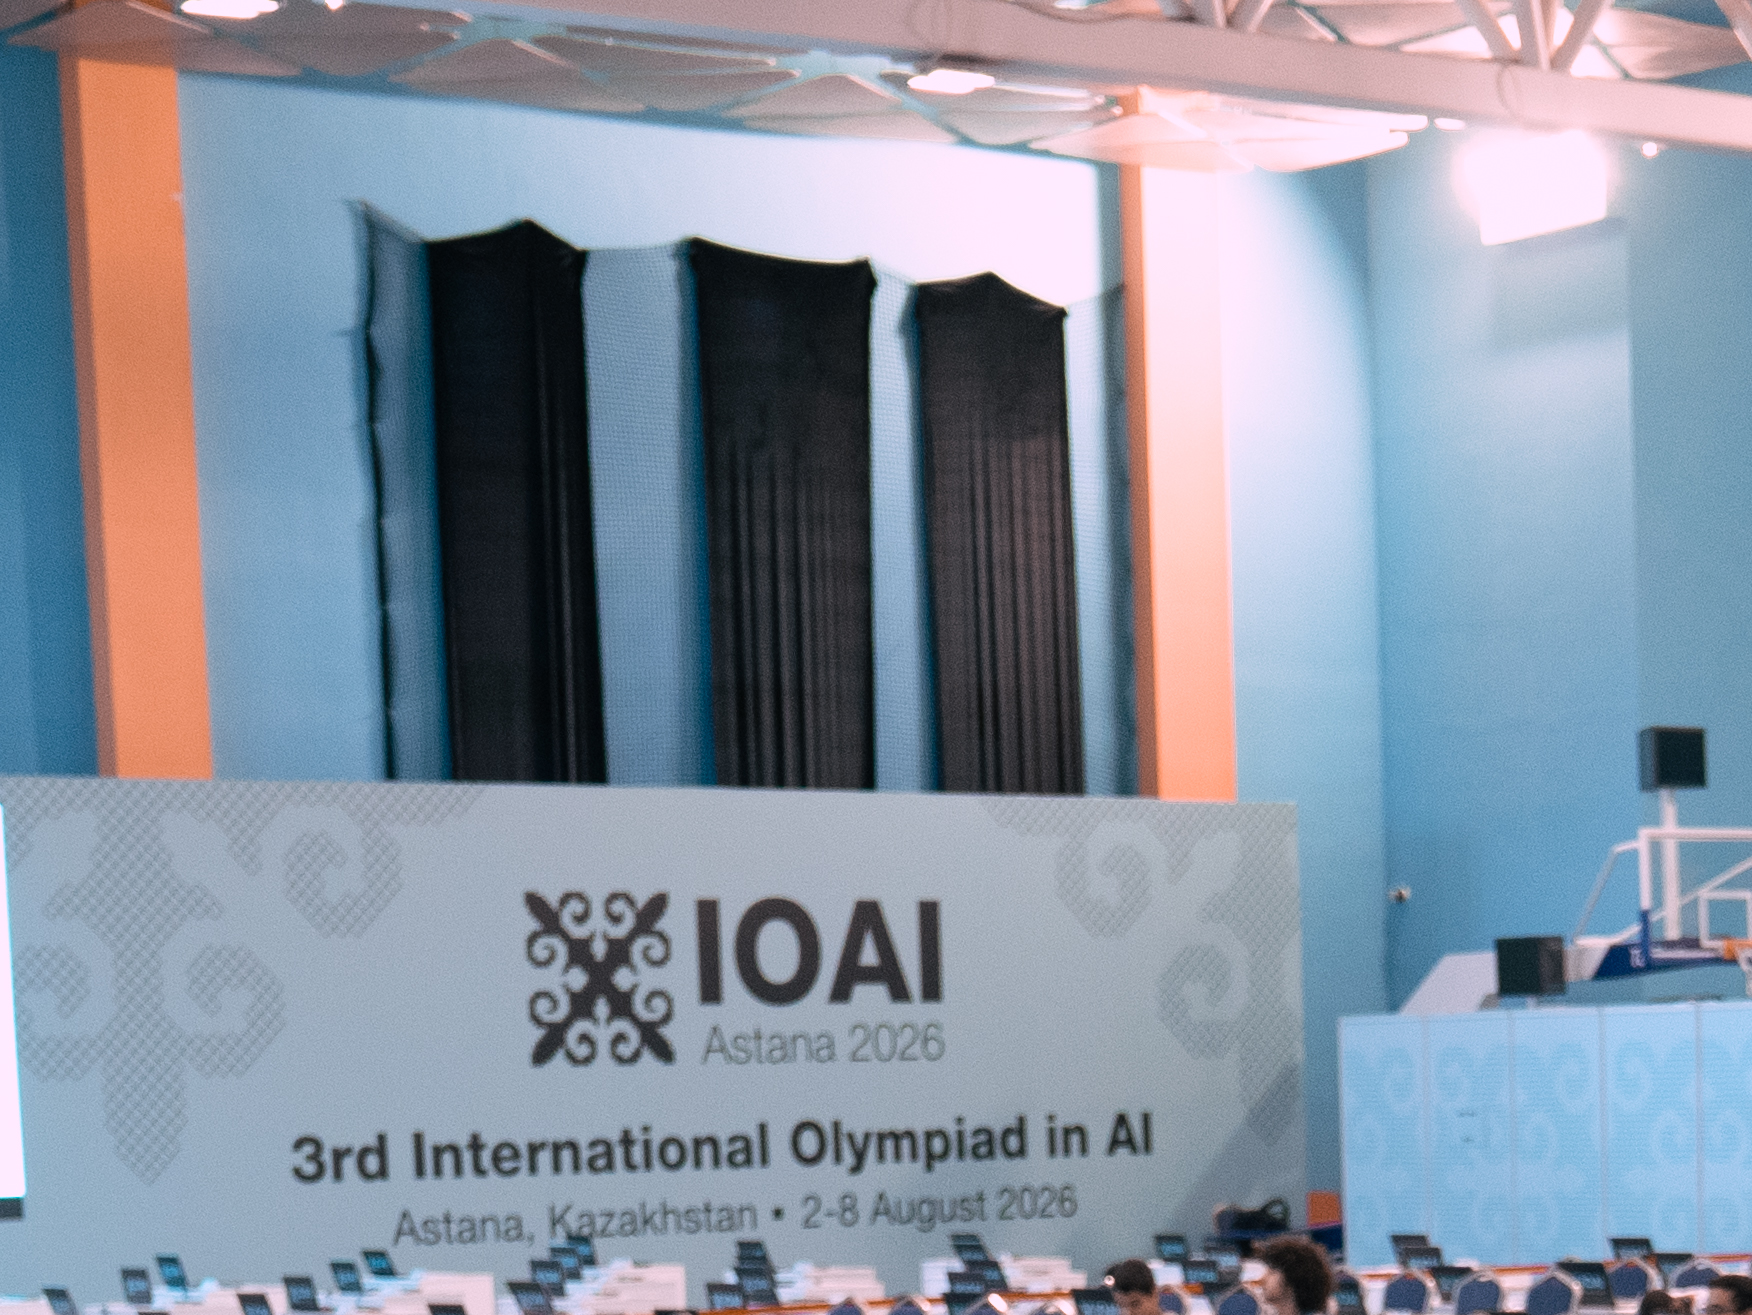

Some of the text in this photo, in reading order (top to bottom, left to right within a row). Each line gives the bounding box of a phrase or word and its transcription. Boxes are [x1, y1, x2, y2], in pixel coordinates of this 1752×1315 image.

[694, 896, 946, 1007] IOAI
[700, 1020, 946, 1066] Astana 2026
[291, 1111, 1154, 1184] 3rd International Olympiad in AI
[393, 1184, 1078, 1249] Astana, Kazakhstan 2-8 August 2026
